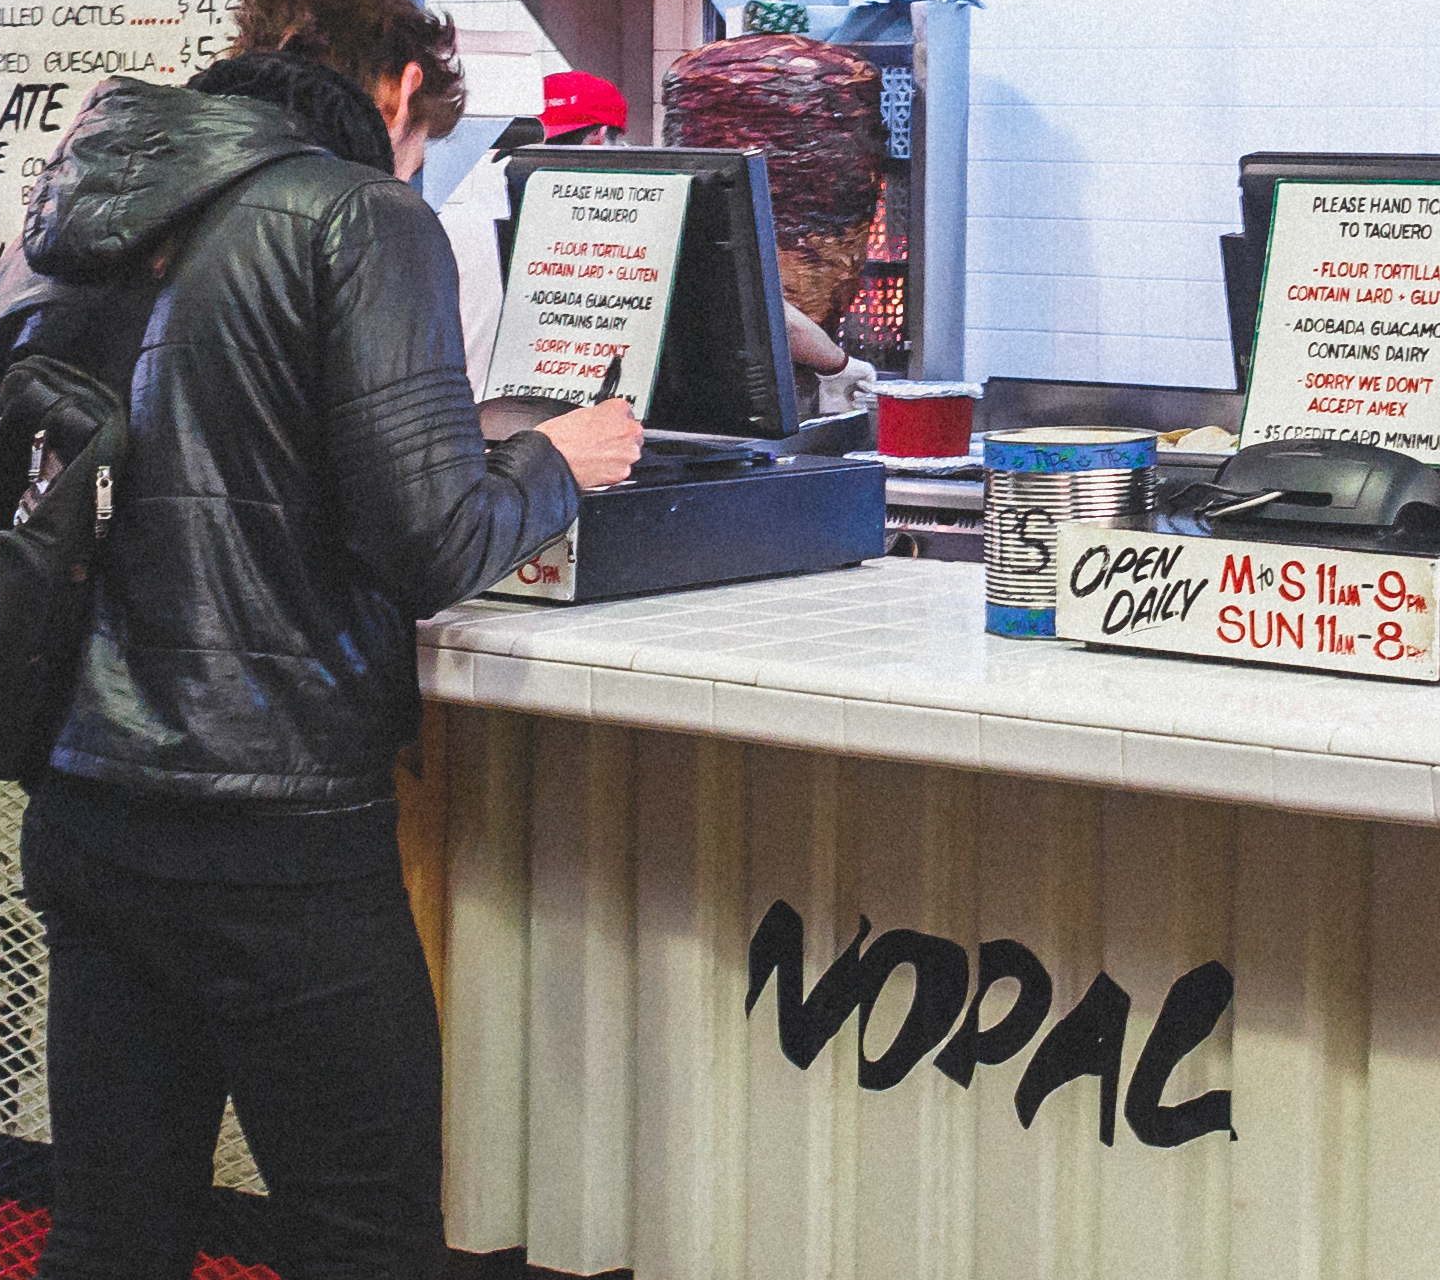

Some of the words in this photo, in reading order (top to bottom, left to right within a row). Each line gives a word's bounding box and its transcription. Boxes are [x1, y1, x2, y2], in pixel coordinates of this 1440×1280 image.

[51, 4, 126, 27] CACTUS
[551, 184, 593, 200] PLEASE
[594, 186, 624, 202] HAND
[628, 187, 665, 203] TICKET
[571, 206, 587, 222] TO
[588, 207, 638, 224] TAQUERO
[1312, 196, 1367, 214] PLEASE
[1369, 197, 1412, 215] HAND
[1338, 221, 1360, 239] TO
[1364, 222, 1433, 240] TAQUERO
[591, 243, 648, 261] TORTILLAS
[527, 261, 575, 278] CONTAIN
[578, 264, 605, 280] LARD
[616, 266, 660, 283] GLUTEN
[585, 293, 654, 312] GUACAMOLE
[1287, 285, 1351, 303] CONTAIN
[1355, 287, 1393, 305] LARD
[538, 312, 594, 330] CONTAINS
[595, 315, 629, 332] DAIRY
[573, 341, 592, 357] WE
[593, 342, 632, 359] DON'T
[1307, 341, 1381, 361] CONTAINS
[1385, 345, 1430, 363] DAIRY
[533, 359, 578, 377] ACCEPT
[1357, 375, 1383, 393] WE
[1385, 376, 1434, 395] DON'T
[1306, 396, 1365, 415] ACCEPT
[1366, 400, 1409, 417] AMEX
[1263, 424, 1282, 441] $5
[1339, 428, 1381, 447] CARD
[1069, 544, 1186, 599] OPEN
[1218, 553, 1256, 595] M
[1256, 566, 1275, 592] to
[1277, 559, 1307, 602] S
[1100, 577, 1210, 637] DAILY
[1215, 604, 1305, 650] SUN
[743, 897, 1239, 1149] NOPAL
